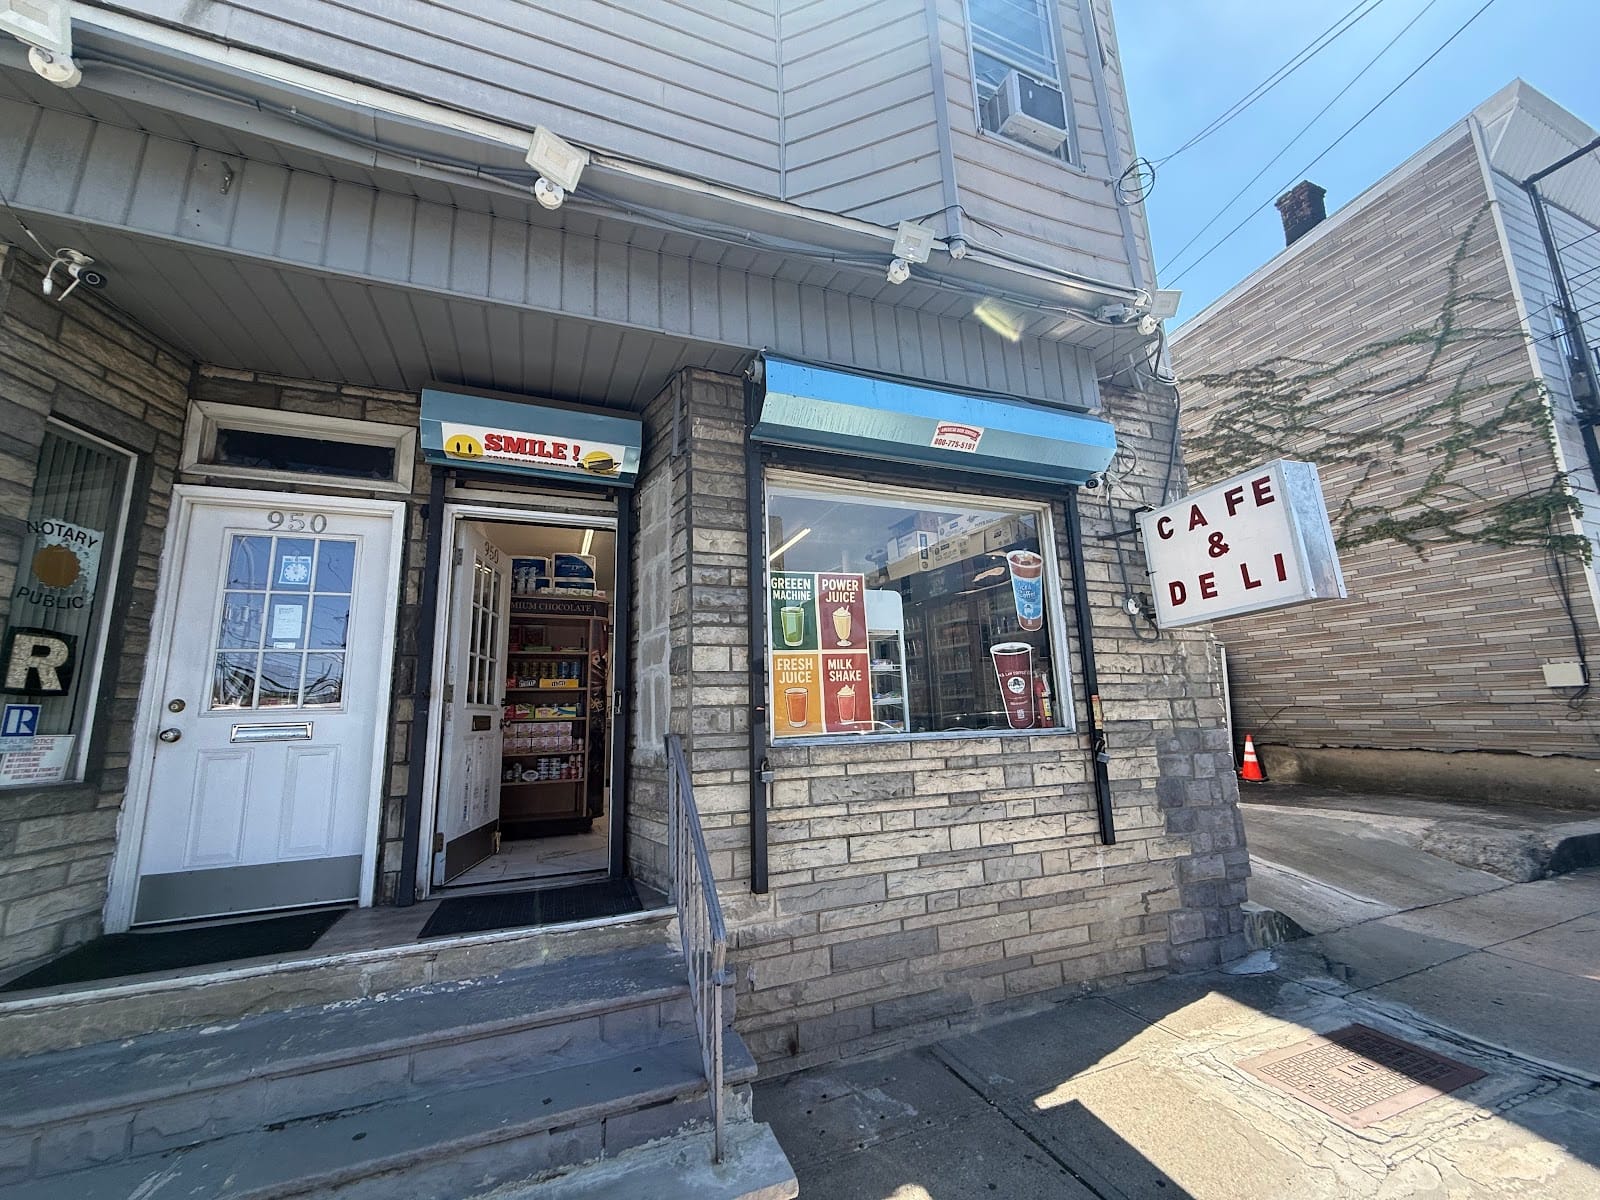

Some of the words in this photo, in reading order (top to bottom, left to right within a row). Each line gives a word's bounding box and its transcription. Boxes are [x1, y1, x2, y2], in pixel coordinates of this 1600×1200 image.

[1157, 475, 1275, 540] CAFE
[267, 511, 328, 533] 950
[27, 521, 98, 548] NOTARY
[1208, 531, 1230, 558] &
[484, 541, 499, 565] 950
[771, 577, 811, 590] GREEEN
[822, 578, 859, 592] POWER
[1169, 553, 1287, 606] DELI
[16, 586, 84, 609] PUBLIC
[772, 590, 811, 601] MACHINE
[825, 591, 856, 603] JUICE
[538, 602, 592, 612] CHOCOLATE
[4, 634, 69, 690] R
[776, 657, 813, 671] FRESH
[827, 658, 852, 671] MILK
[779, 671, 812, 684] JUICE
[829, 670, 862, 682] SHAKE
